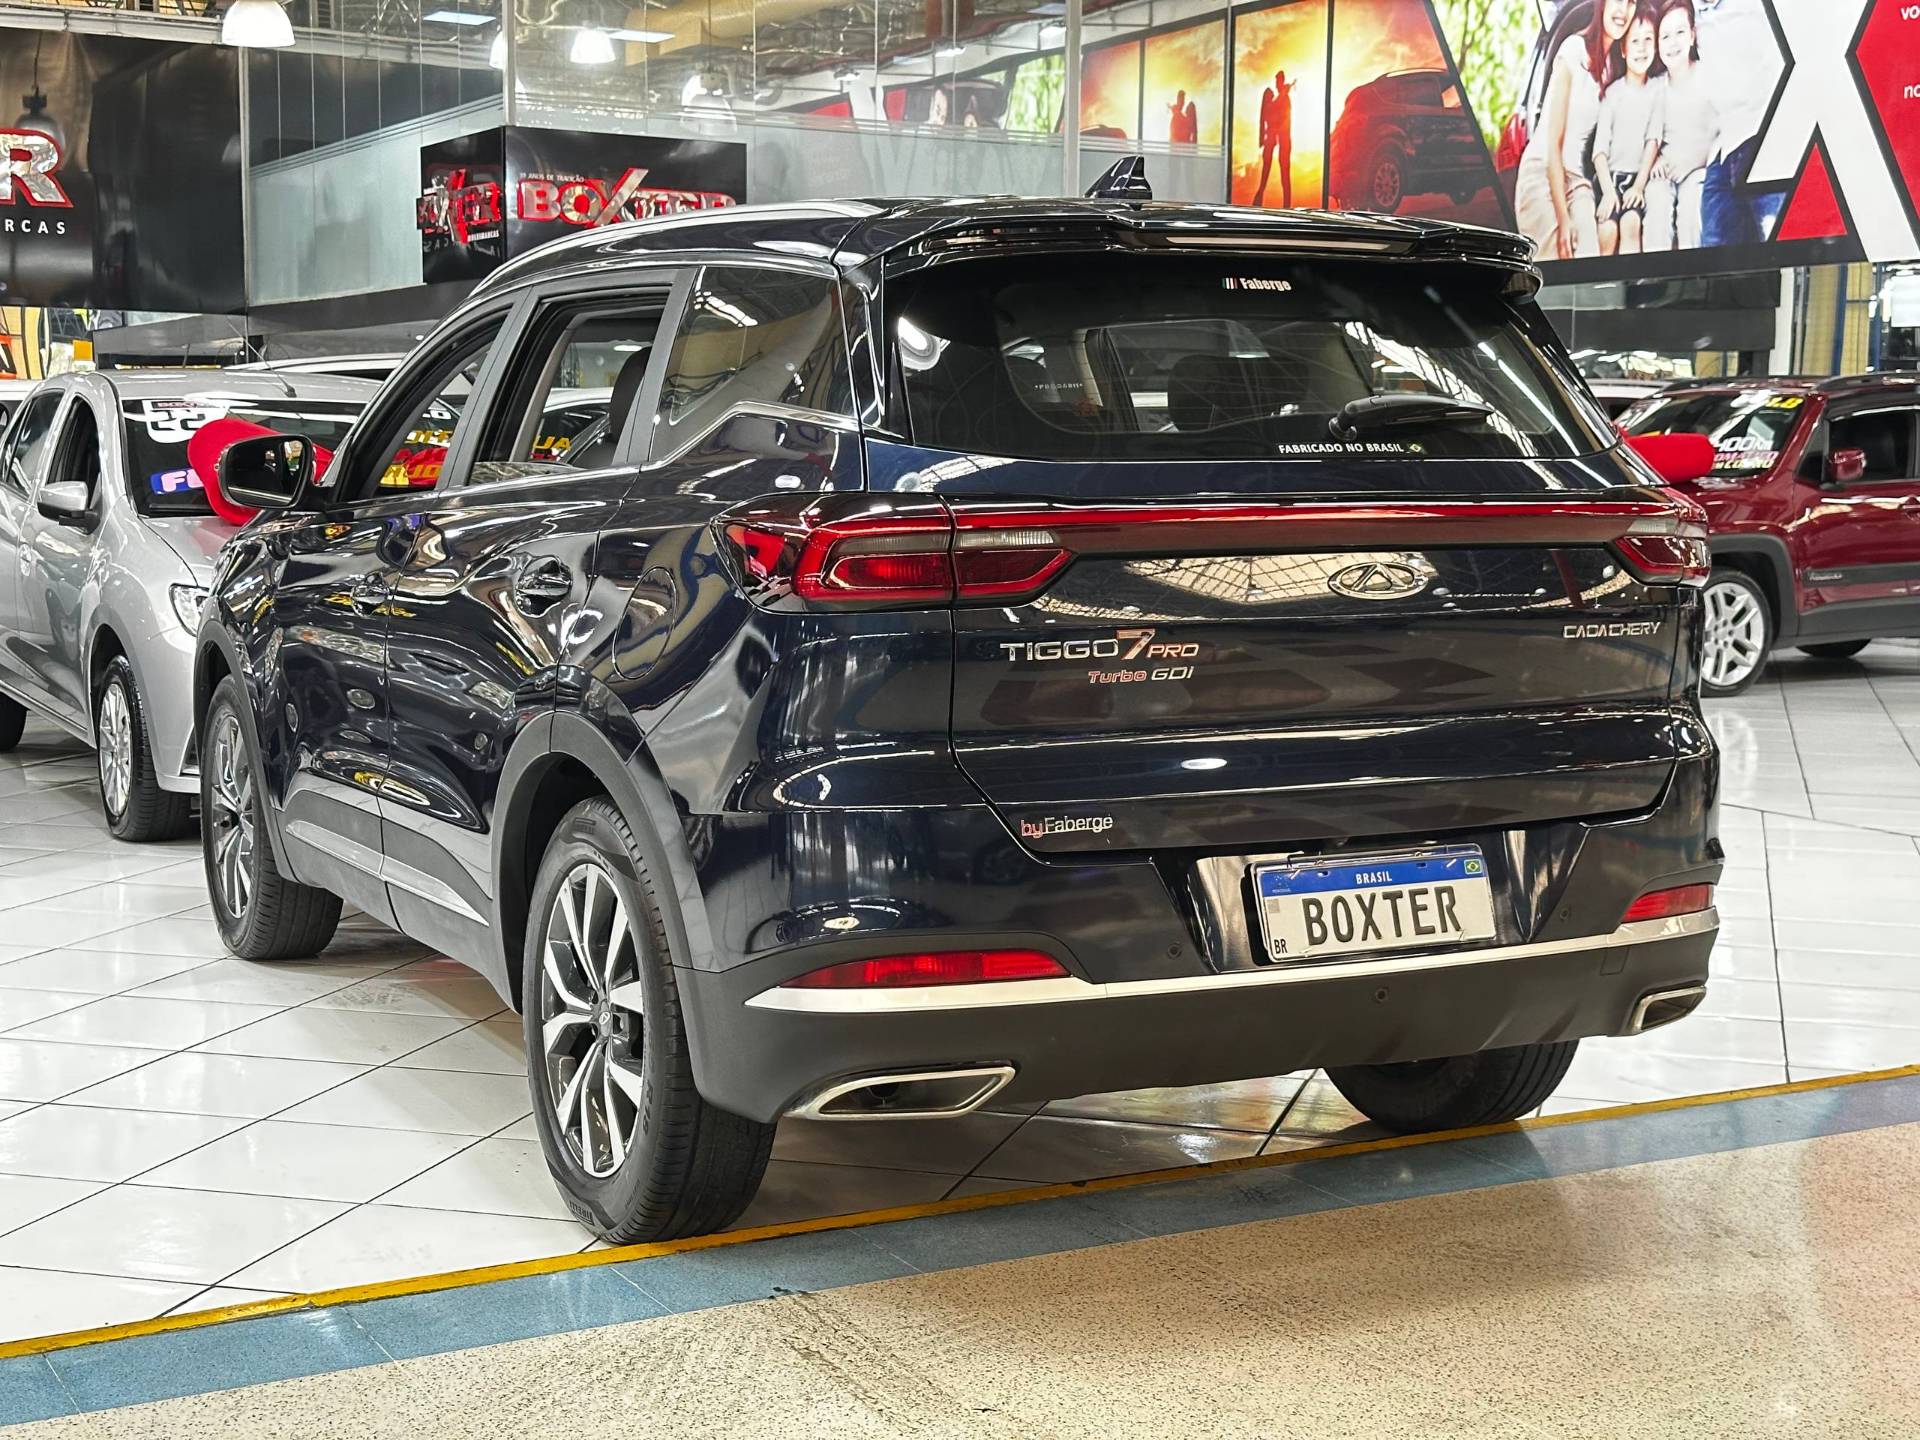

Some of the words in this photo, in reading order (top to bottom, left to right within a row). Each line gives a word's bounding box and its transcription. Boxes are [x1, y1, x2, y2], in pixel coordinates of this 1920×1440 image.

[5, 219, 66, 235] RCAS
[1239, 277, 1292, 292] Faberge
[1278, 443, 1343, 454] FABRICADO
[1345, 443, 1364, 452] NO
[1365, 443, 1404, 452] BRASIL
[1000, 639, 1120, 661] TIGGO
[1116, 628, 1156, 661] 7
[1147, 643, 1200, 658] PRO
[1088, 670, 1148, 684] Turbo
[1355, 871, 1393, 884] BRASIL
[1301, 885, 1461, 946] BOXTER
[1274, 939, 1288, 954] BR
